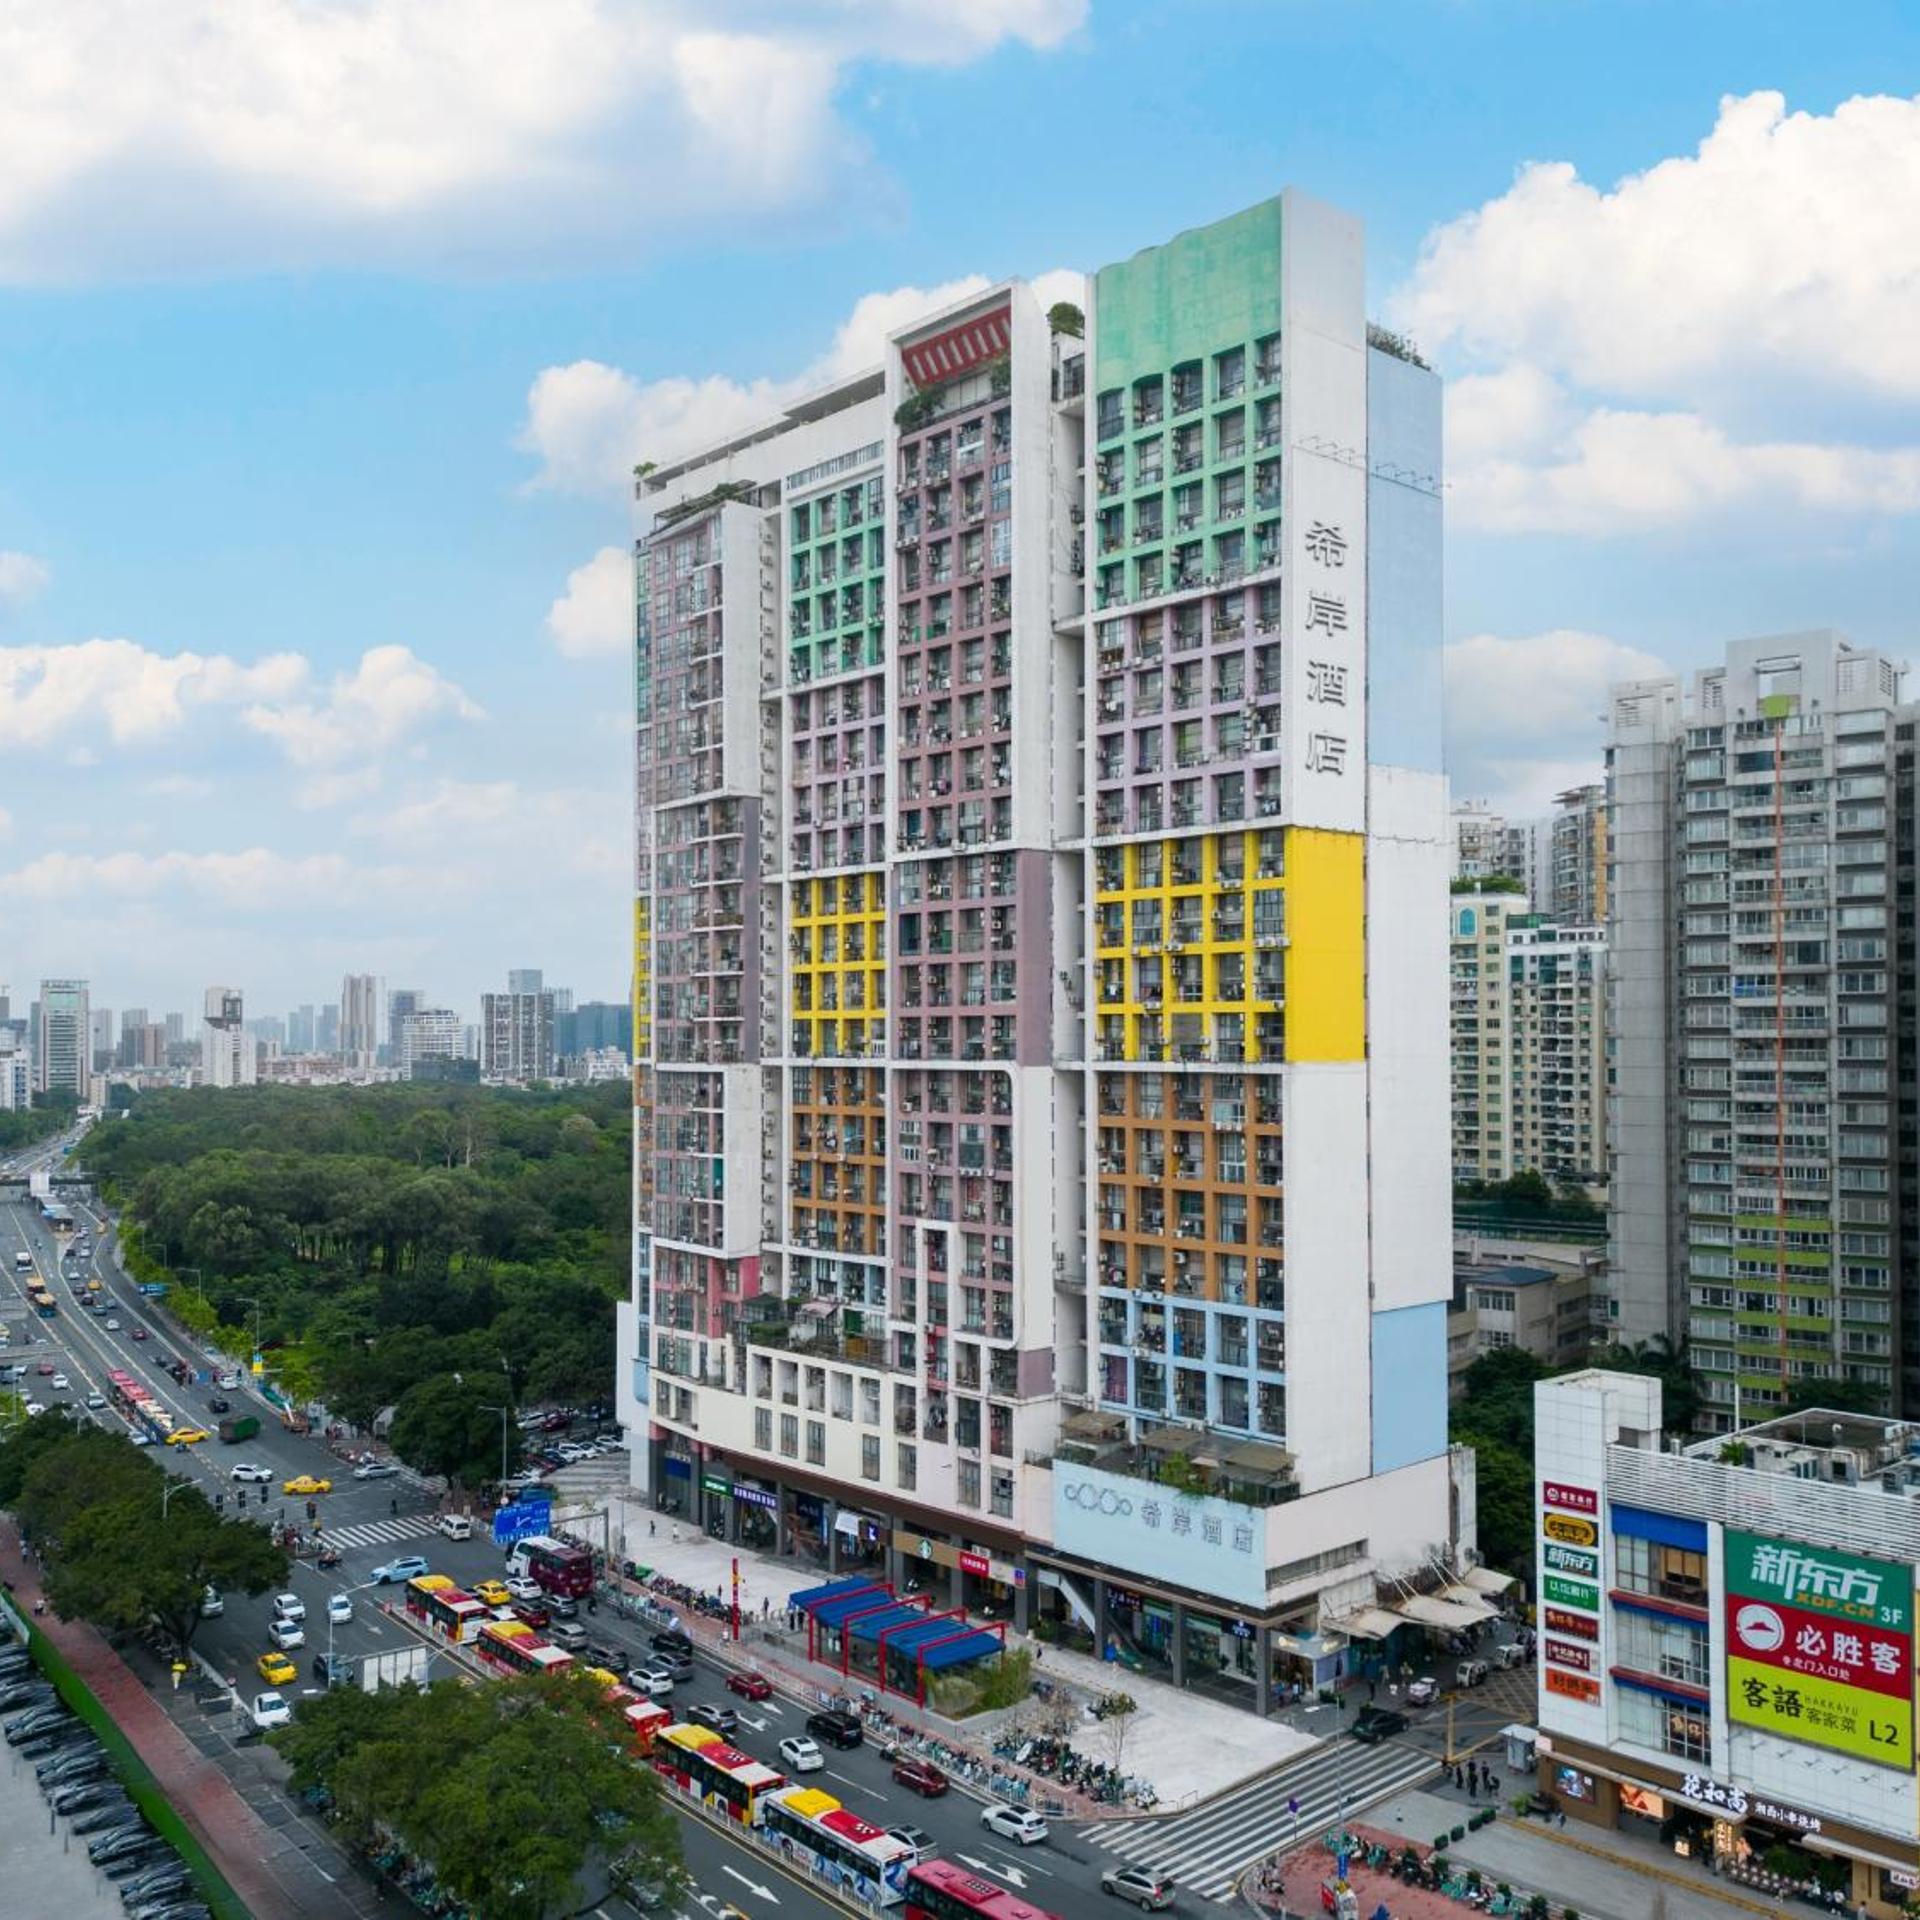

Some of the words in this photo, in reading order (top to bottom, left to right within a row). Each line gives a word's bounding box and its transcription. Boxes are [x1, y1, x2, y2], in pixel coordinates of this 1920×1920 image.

[1305, 520, 1349, 776] 希岸酒店
[1141, 1500, 1253, 1553] 希岸酒店
[1752, 1544, 1883, 1605] 新东方
[1881, 1606, 1903, 1625] 3F
[1796, 1624, 1901, 1676] 必胜客
[1742, 1677, 1804, 1719] 客語
[1806, 1707, 1857, 1735] 客家菜
[1870, 1720, 1900, 1746] L2
[1681, 1773, 1748, 1814] 花和尚
